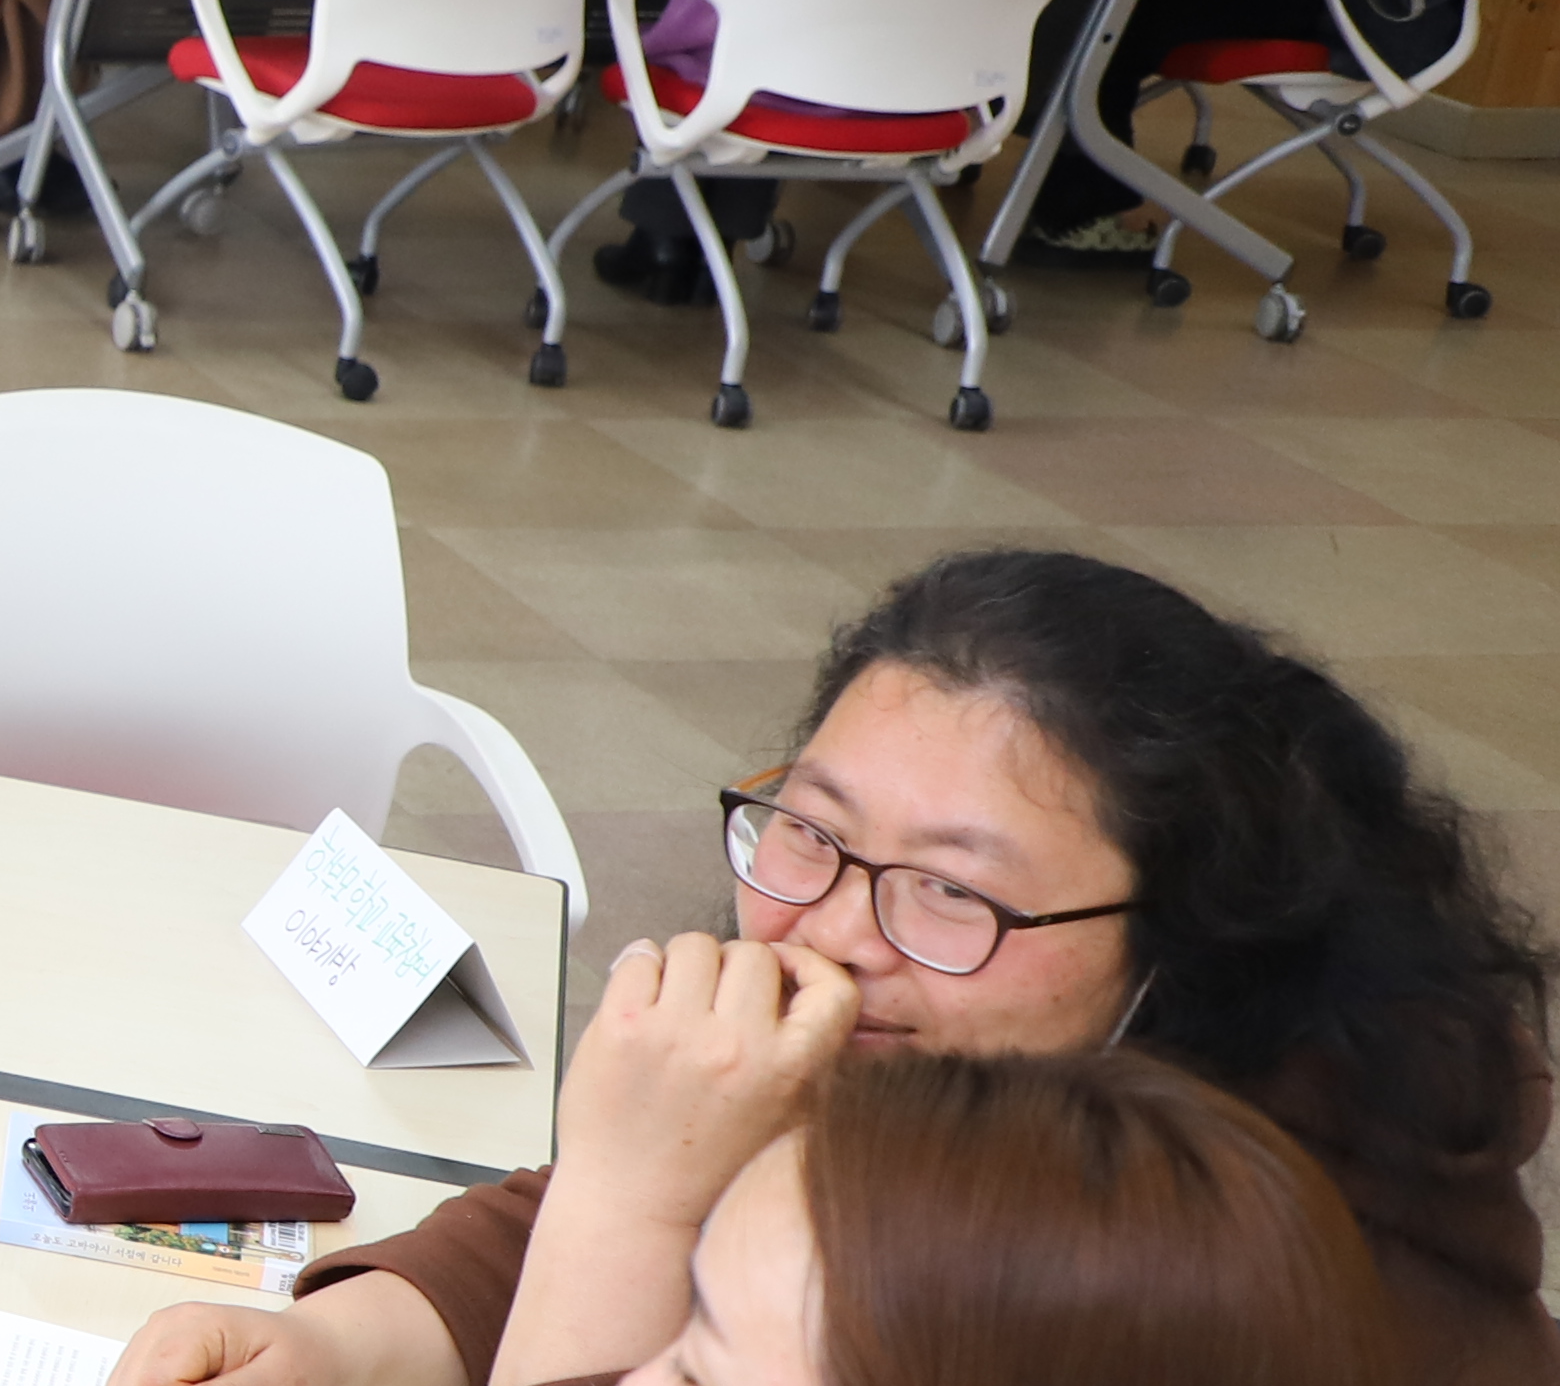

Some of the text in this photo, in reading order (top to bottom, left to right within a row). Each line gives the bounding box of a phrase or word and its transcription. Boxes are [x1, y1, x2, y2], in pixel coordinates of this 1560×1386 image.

[305, 825, 360, 901] 학부모
[285, 907, 362, 986] 이야기방
[30, 1231, 183, 1269] 오늘도 고바야시 서점에 갑니다
